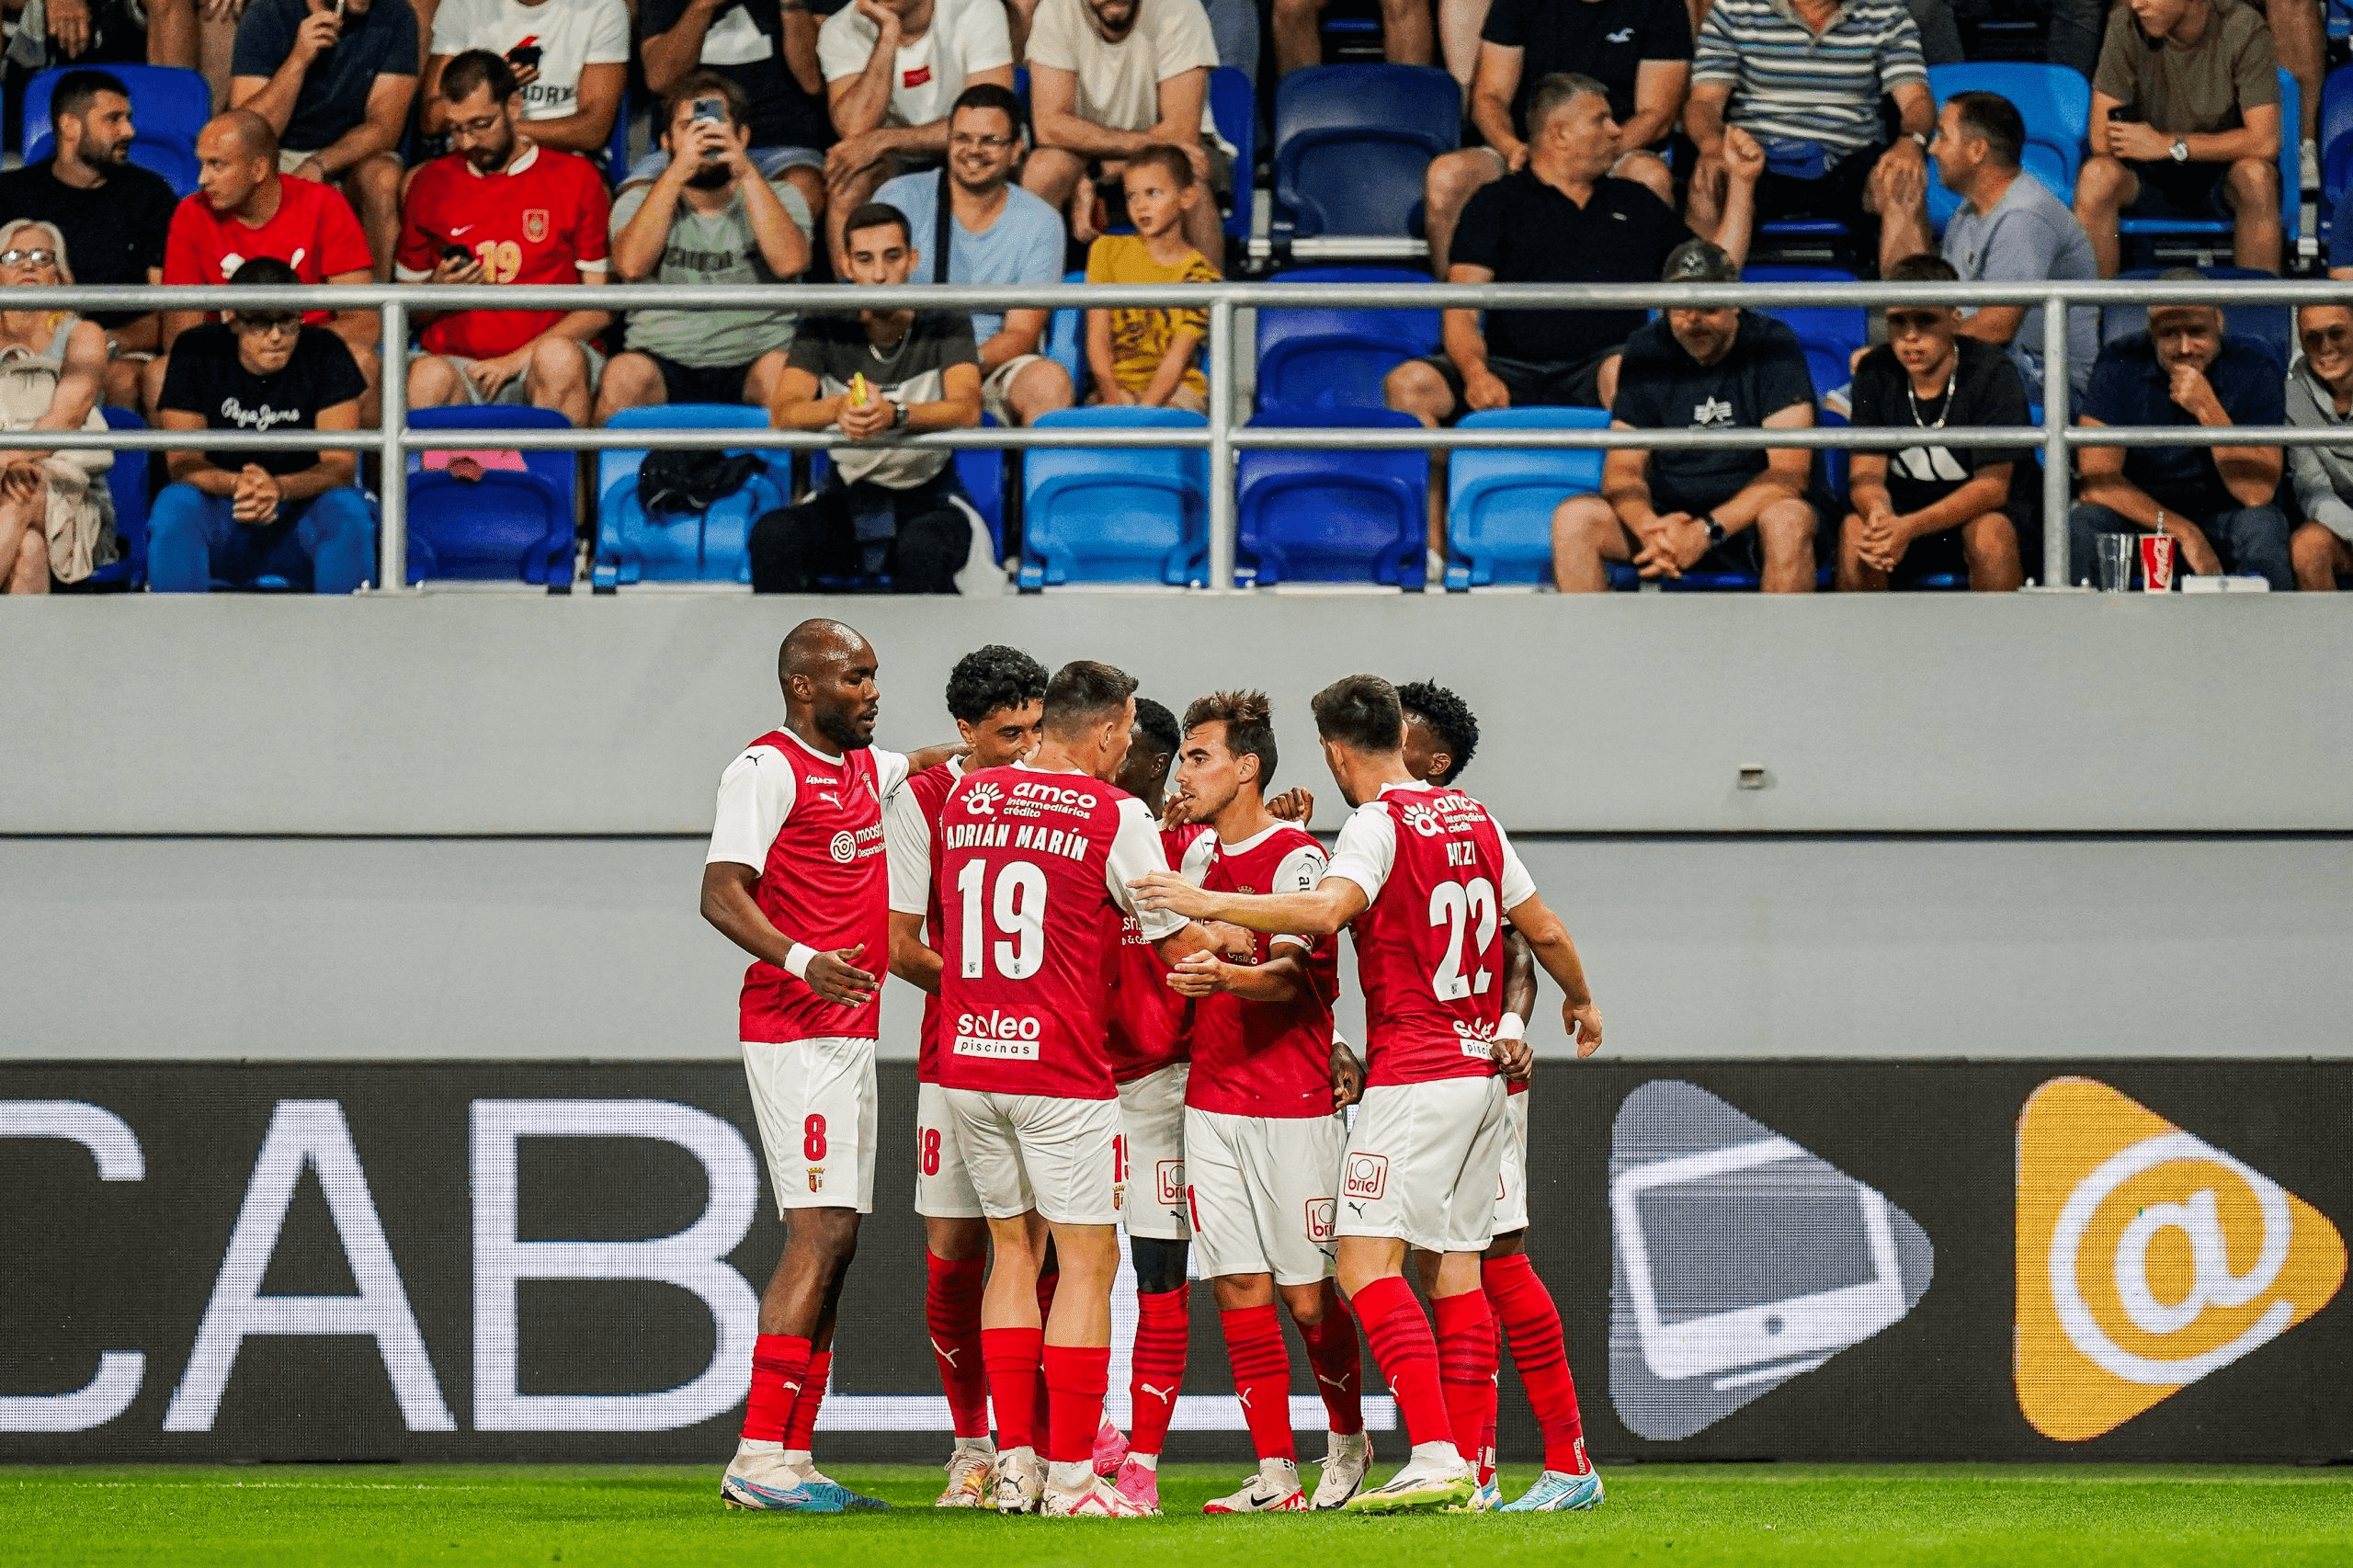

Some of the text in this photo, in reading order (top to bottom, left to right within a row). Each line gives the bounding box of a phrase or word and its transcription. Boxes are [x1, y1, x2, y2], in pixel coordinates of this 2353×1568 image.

[475, 240, 522, 284] 19
[1012, 781, 1097, 809] amco
[946, 816, 1089, 862] ADRIÁN MARÍN
[957, 857, 1048, 981] 19
[1428, 877, 1497, 1002] 22
[956, 1009, 1040, 1040] soleo
[961, 1040, 1030, 1055] piscinas
[1467, 1041, 1490, 1056] pisci
[804, 1113, 827, 1161] 8
[1112, 1133, 1130, 1183] 1
